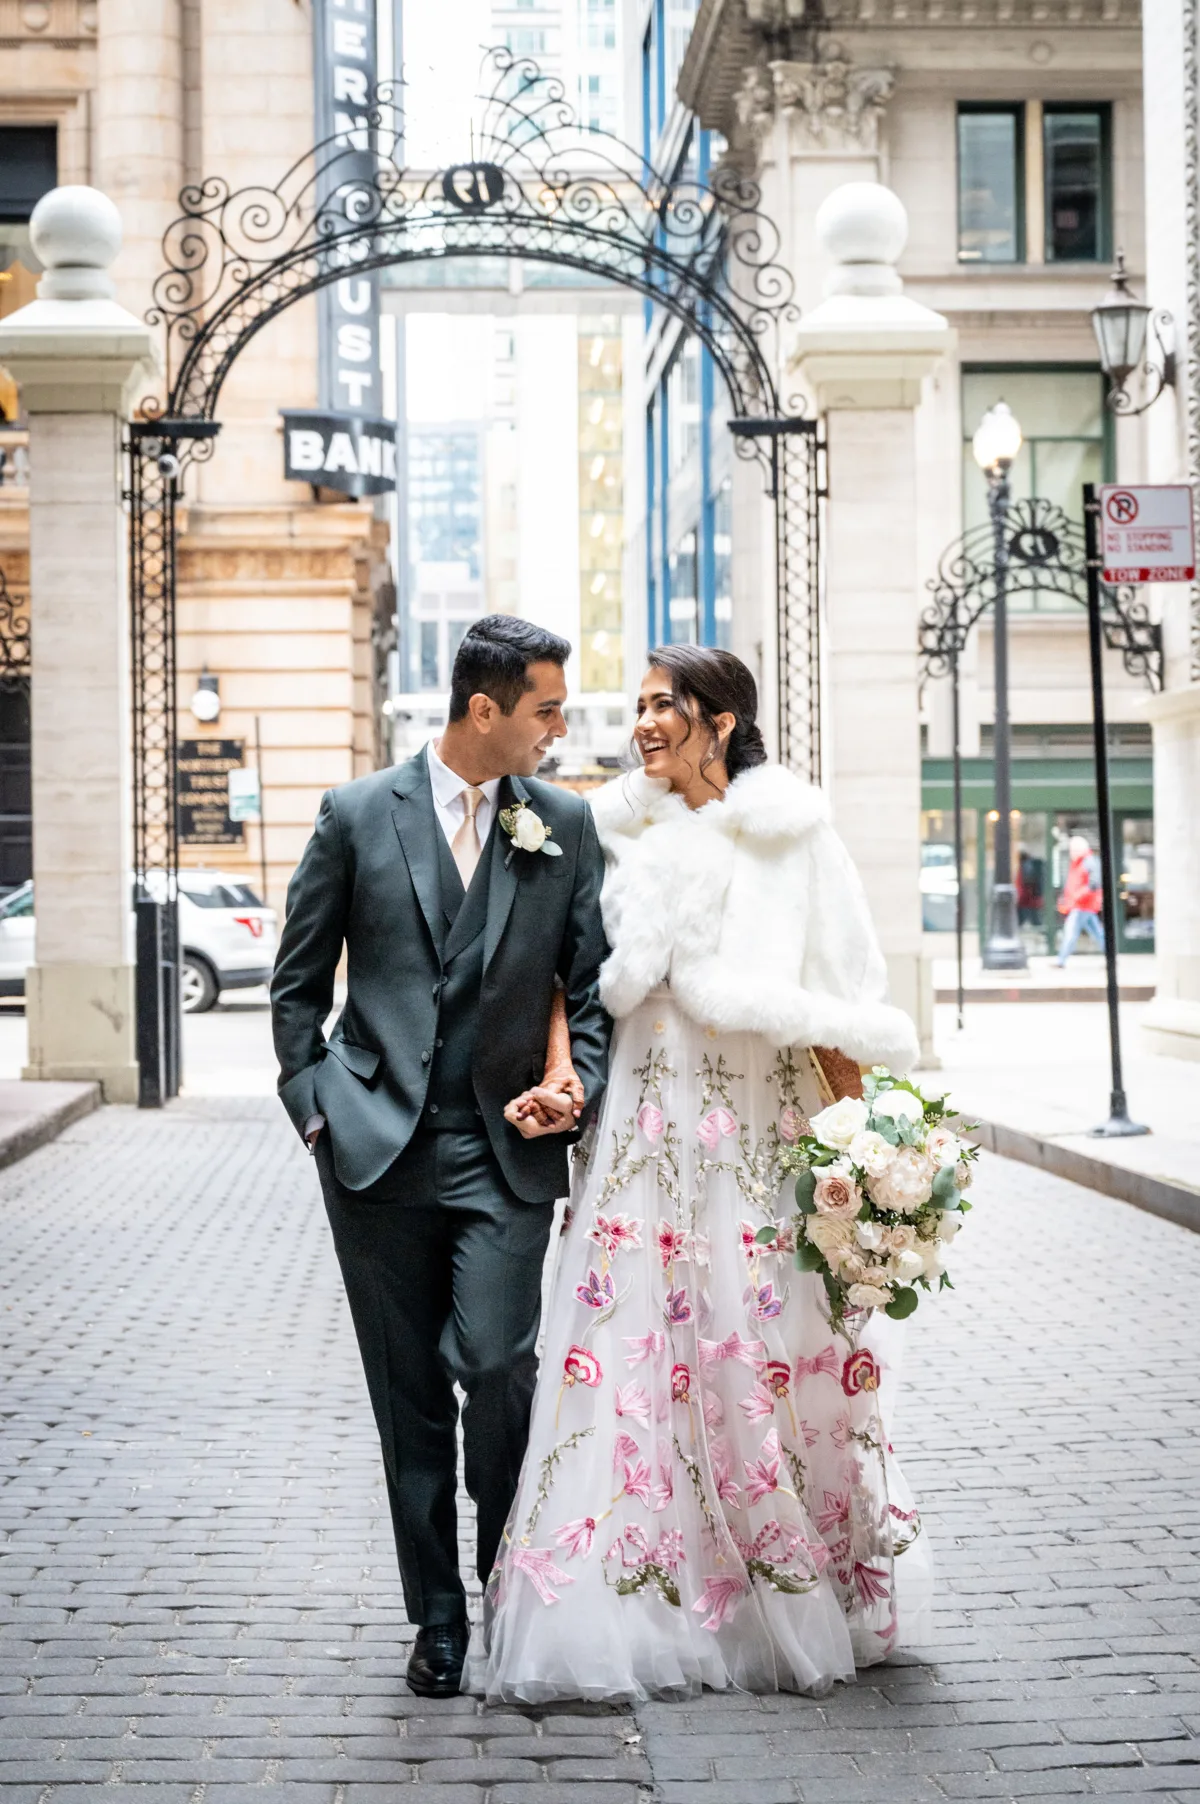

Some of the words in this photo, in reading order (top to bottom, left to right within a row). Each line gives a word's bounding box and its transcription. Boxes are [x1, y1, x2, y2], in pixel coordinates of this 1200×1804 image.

[333, 0, 369, 151] ERN
[1107, 533, 1121, 542] NO
[1107, 544, 1121, 553] NO
[1108, 567, 1140, 582] TOW
[1147, 566, 1187, 581] ZONE
